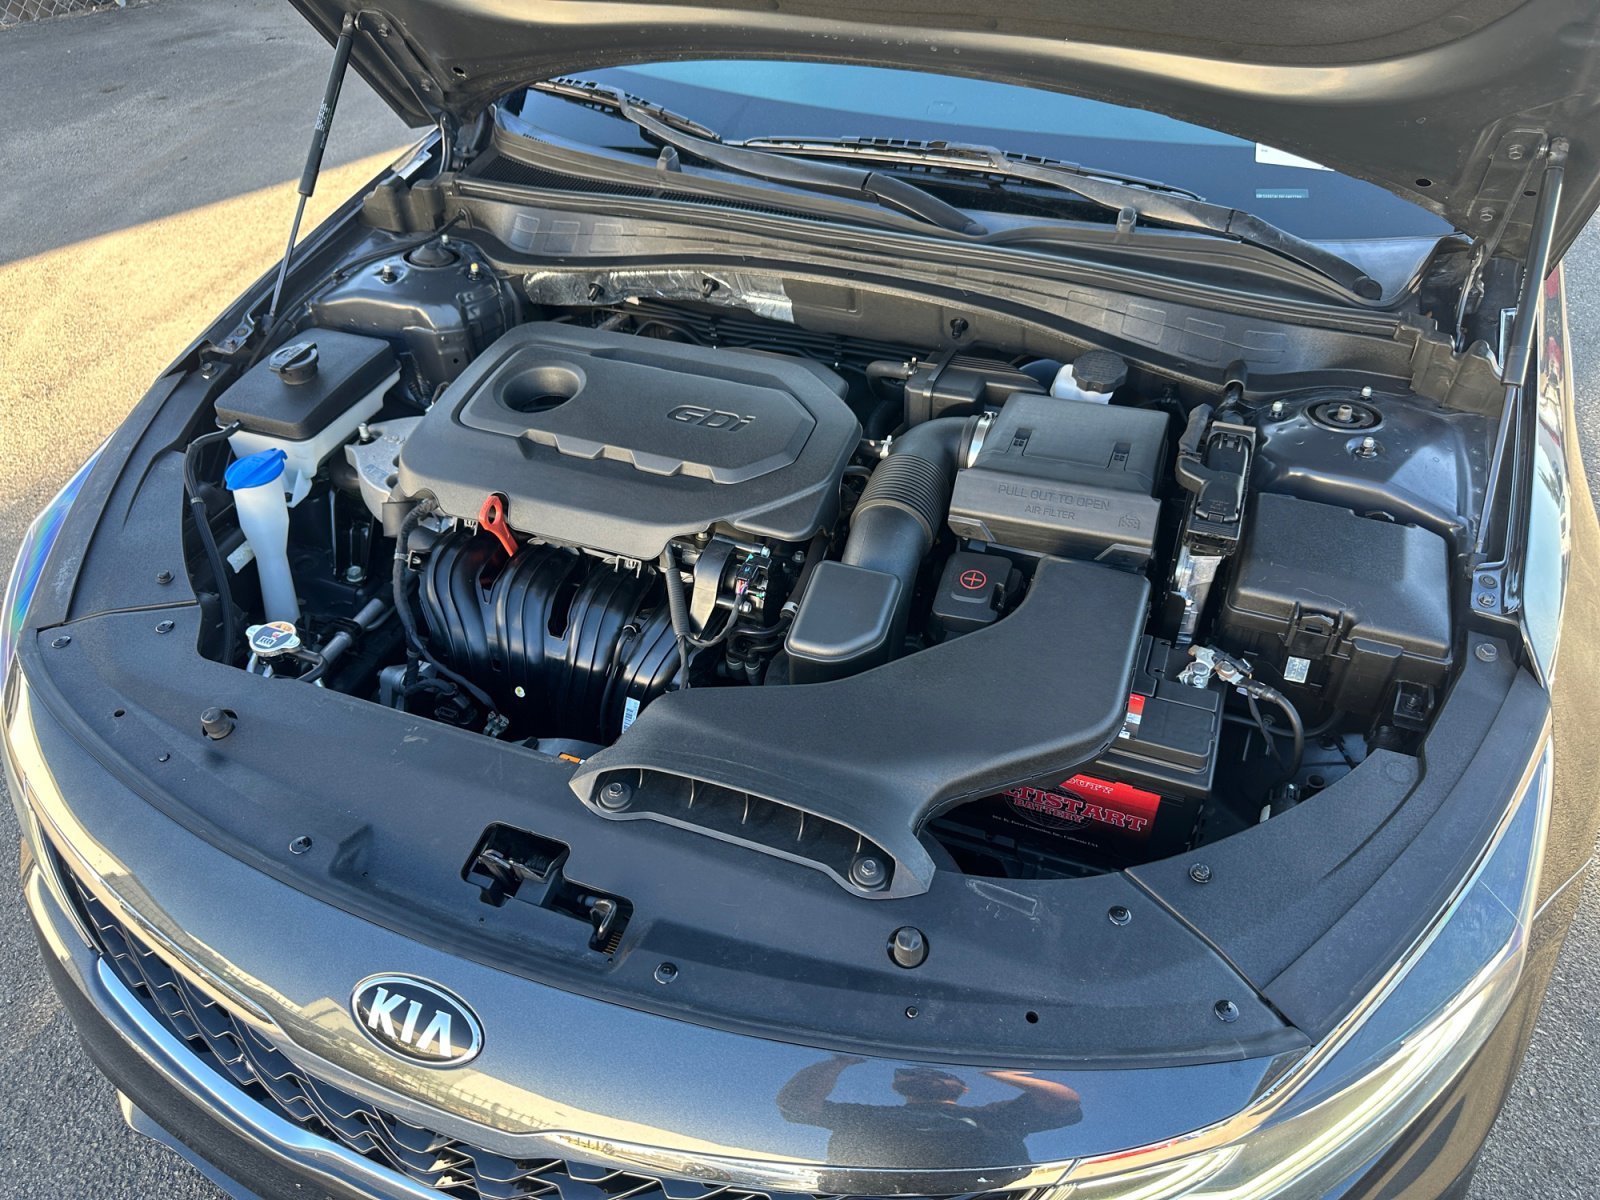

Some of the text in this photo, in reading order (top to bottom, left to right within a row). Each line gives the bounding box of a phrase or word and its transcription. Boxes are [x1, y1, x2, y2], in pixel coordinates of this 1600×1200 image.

[667, 404, 757, 433] GDi
[998, 484, 1110, 511] PULL OUT TO OPEN
[1024, 504, 1076, 521] AIR FILTER
[1014, 799, 1084, 823] BATTERY
[367, 986, 453, 1058] KIA
